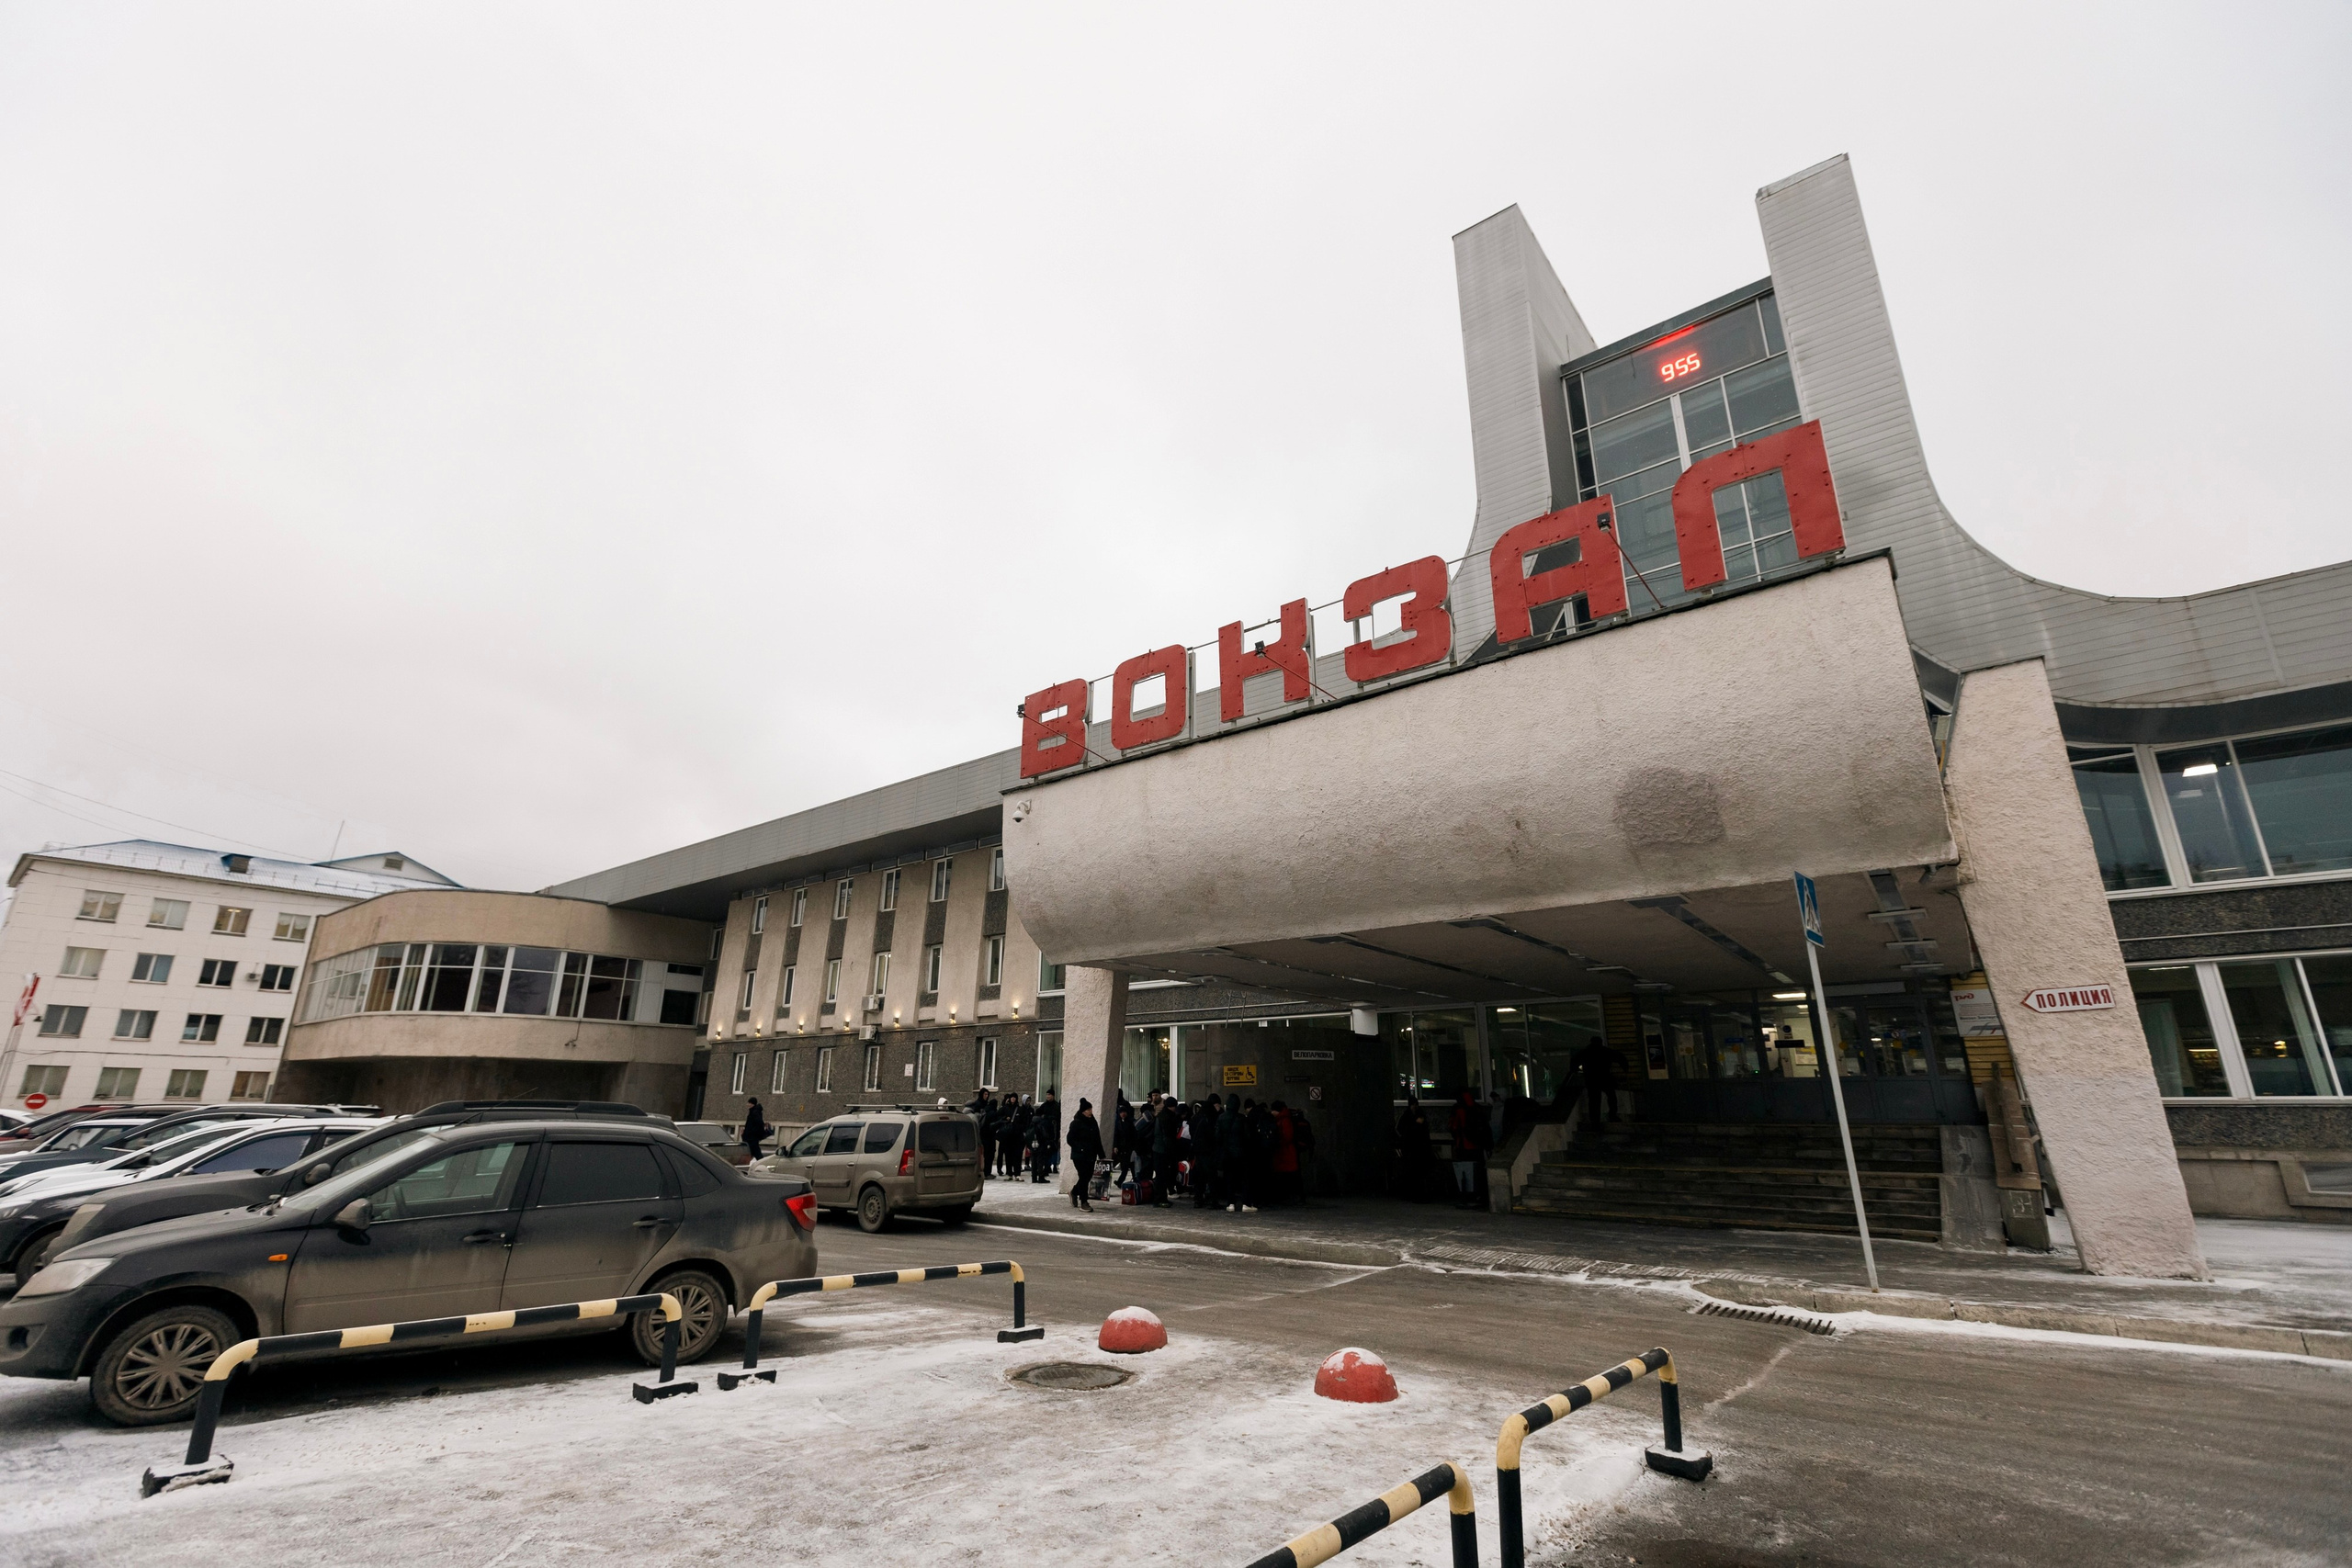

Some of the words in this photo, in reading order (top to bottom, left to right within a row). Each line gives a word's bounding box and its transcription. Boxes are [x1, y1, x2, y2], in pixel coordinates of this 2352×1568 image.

[1020, 419, 1846, 778] ВОКЗАЛ
[2035, 988, 2112, 1009] ПОЛИЦИЯ
[1294, 1051, 1332, 1059] ВЕЛОПАРКОВКА
